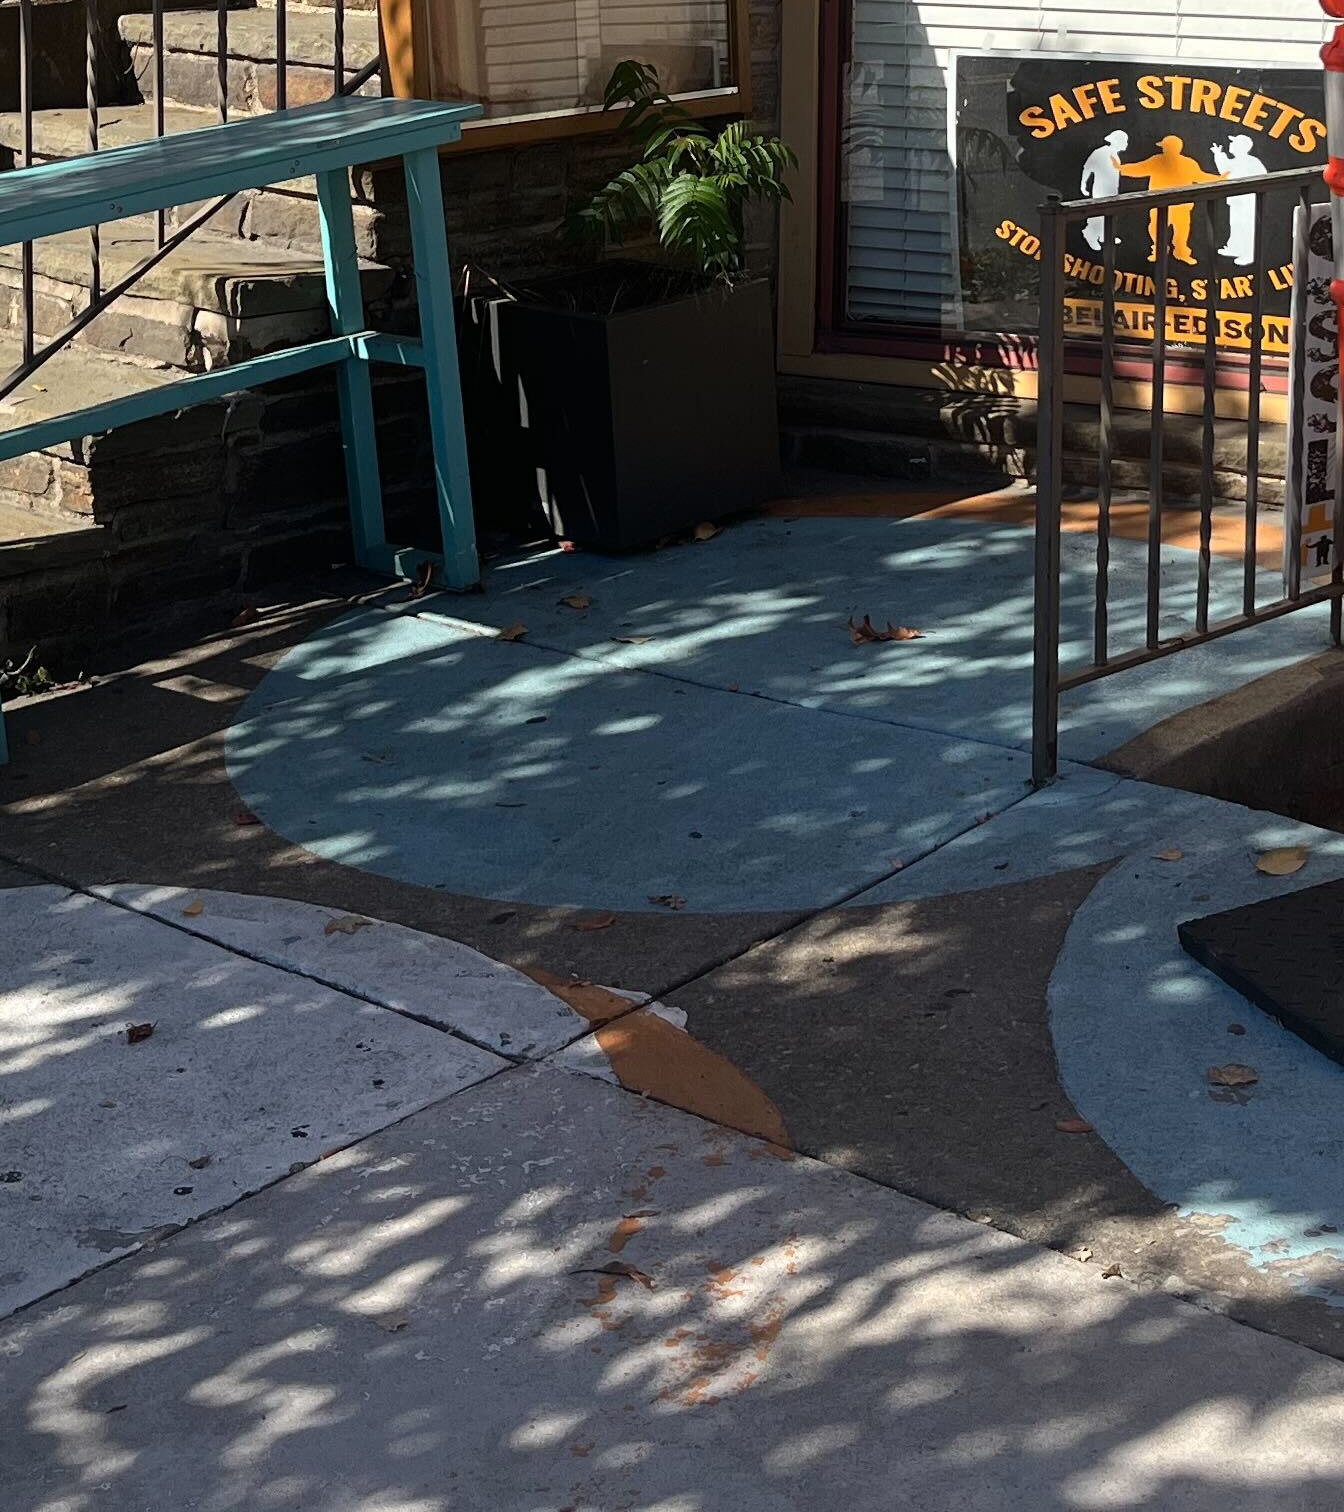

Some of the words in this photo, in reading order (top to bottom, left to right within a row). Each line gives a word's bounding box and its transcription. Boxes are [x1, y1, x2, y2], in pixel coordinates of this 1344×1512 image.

[1018, 78, 1127, 139] SAFE
[1136, 74, 1327, 153] STREETS
[994, 219, 1043, 262] STO
